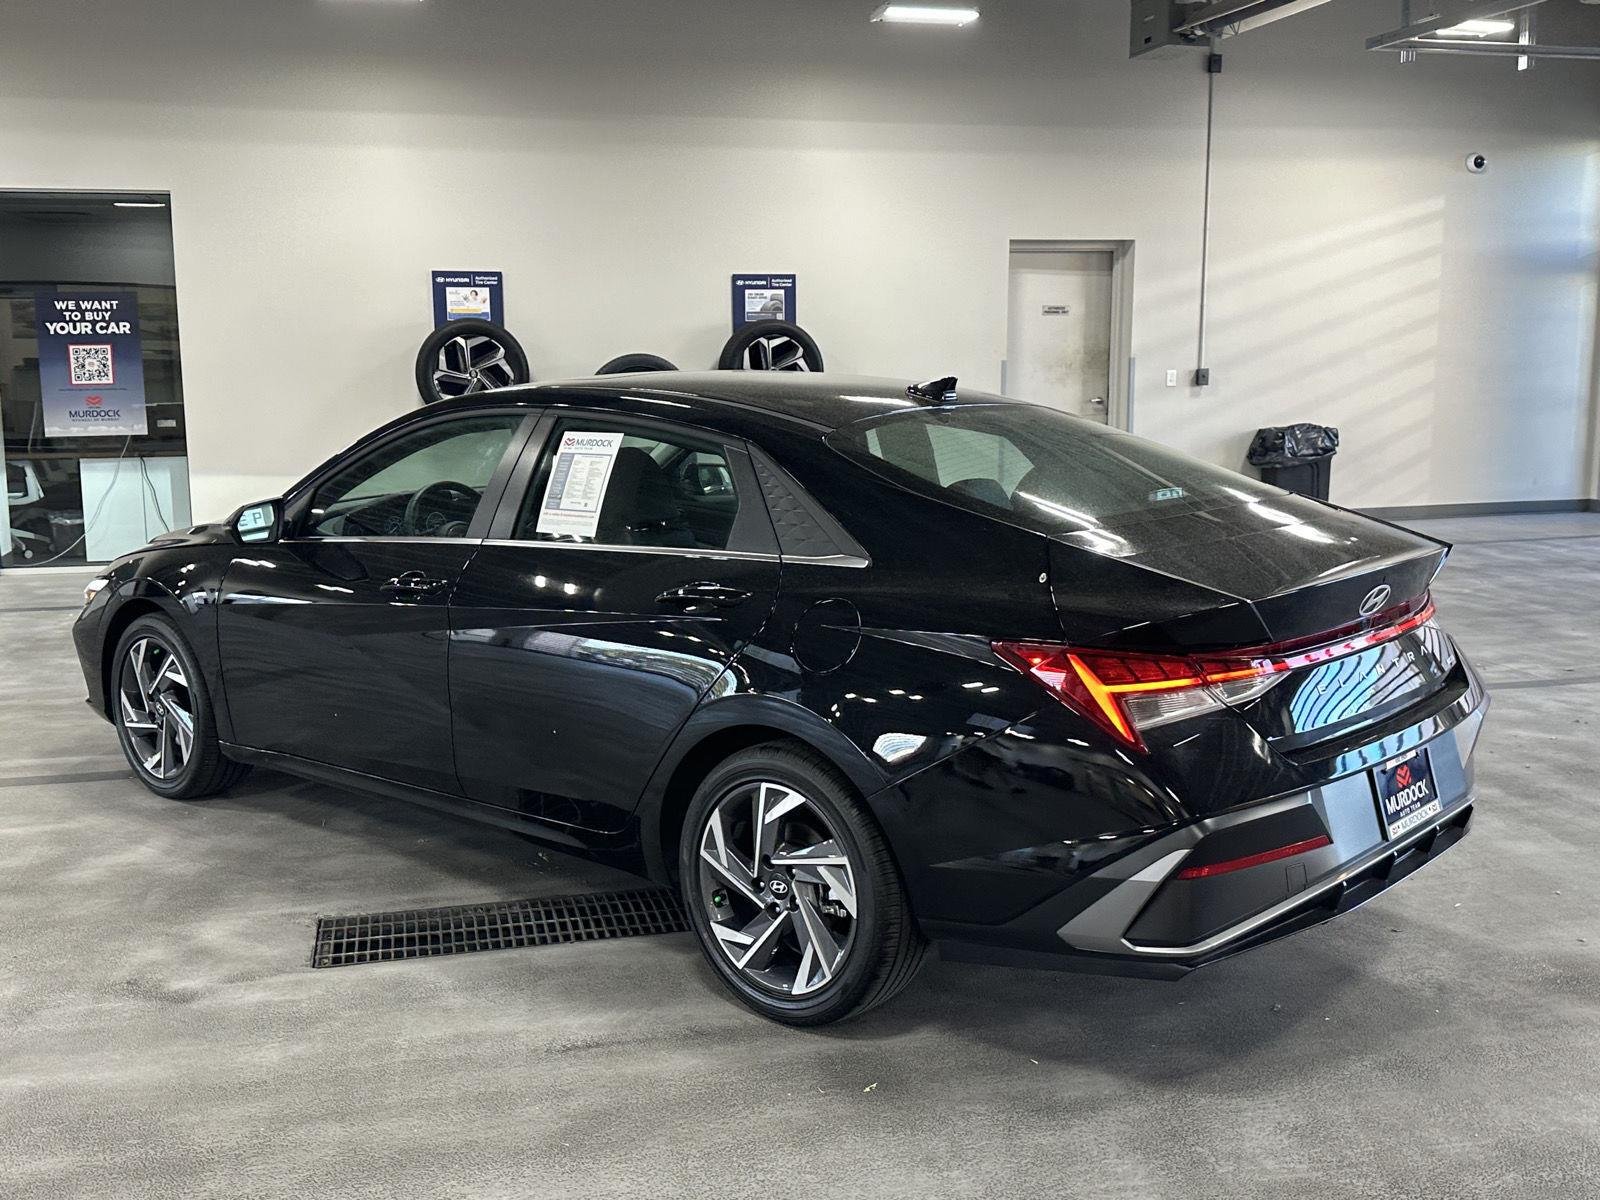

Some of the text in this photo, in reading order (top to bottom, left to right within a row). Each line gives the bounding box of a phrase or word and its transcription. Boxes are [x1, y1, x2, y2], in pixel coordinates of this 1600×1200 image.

[54, 300, 119, 310] WE WANT
[63, 311, 111, 321] TO BUY
[45, 321, 131, 335] YOUR CAR
[69, 409, 121, 418] MURDOCK
[575, 438, 614, 448] MURDOCK
[1385, 778, 1429, 815] MURDOCK
